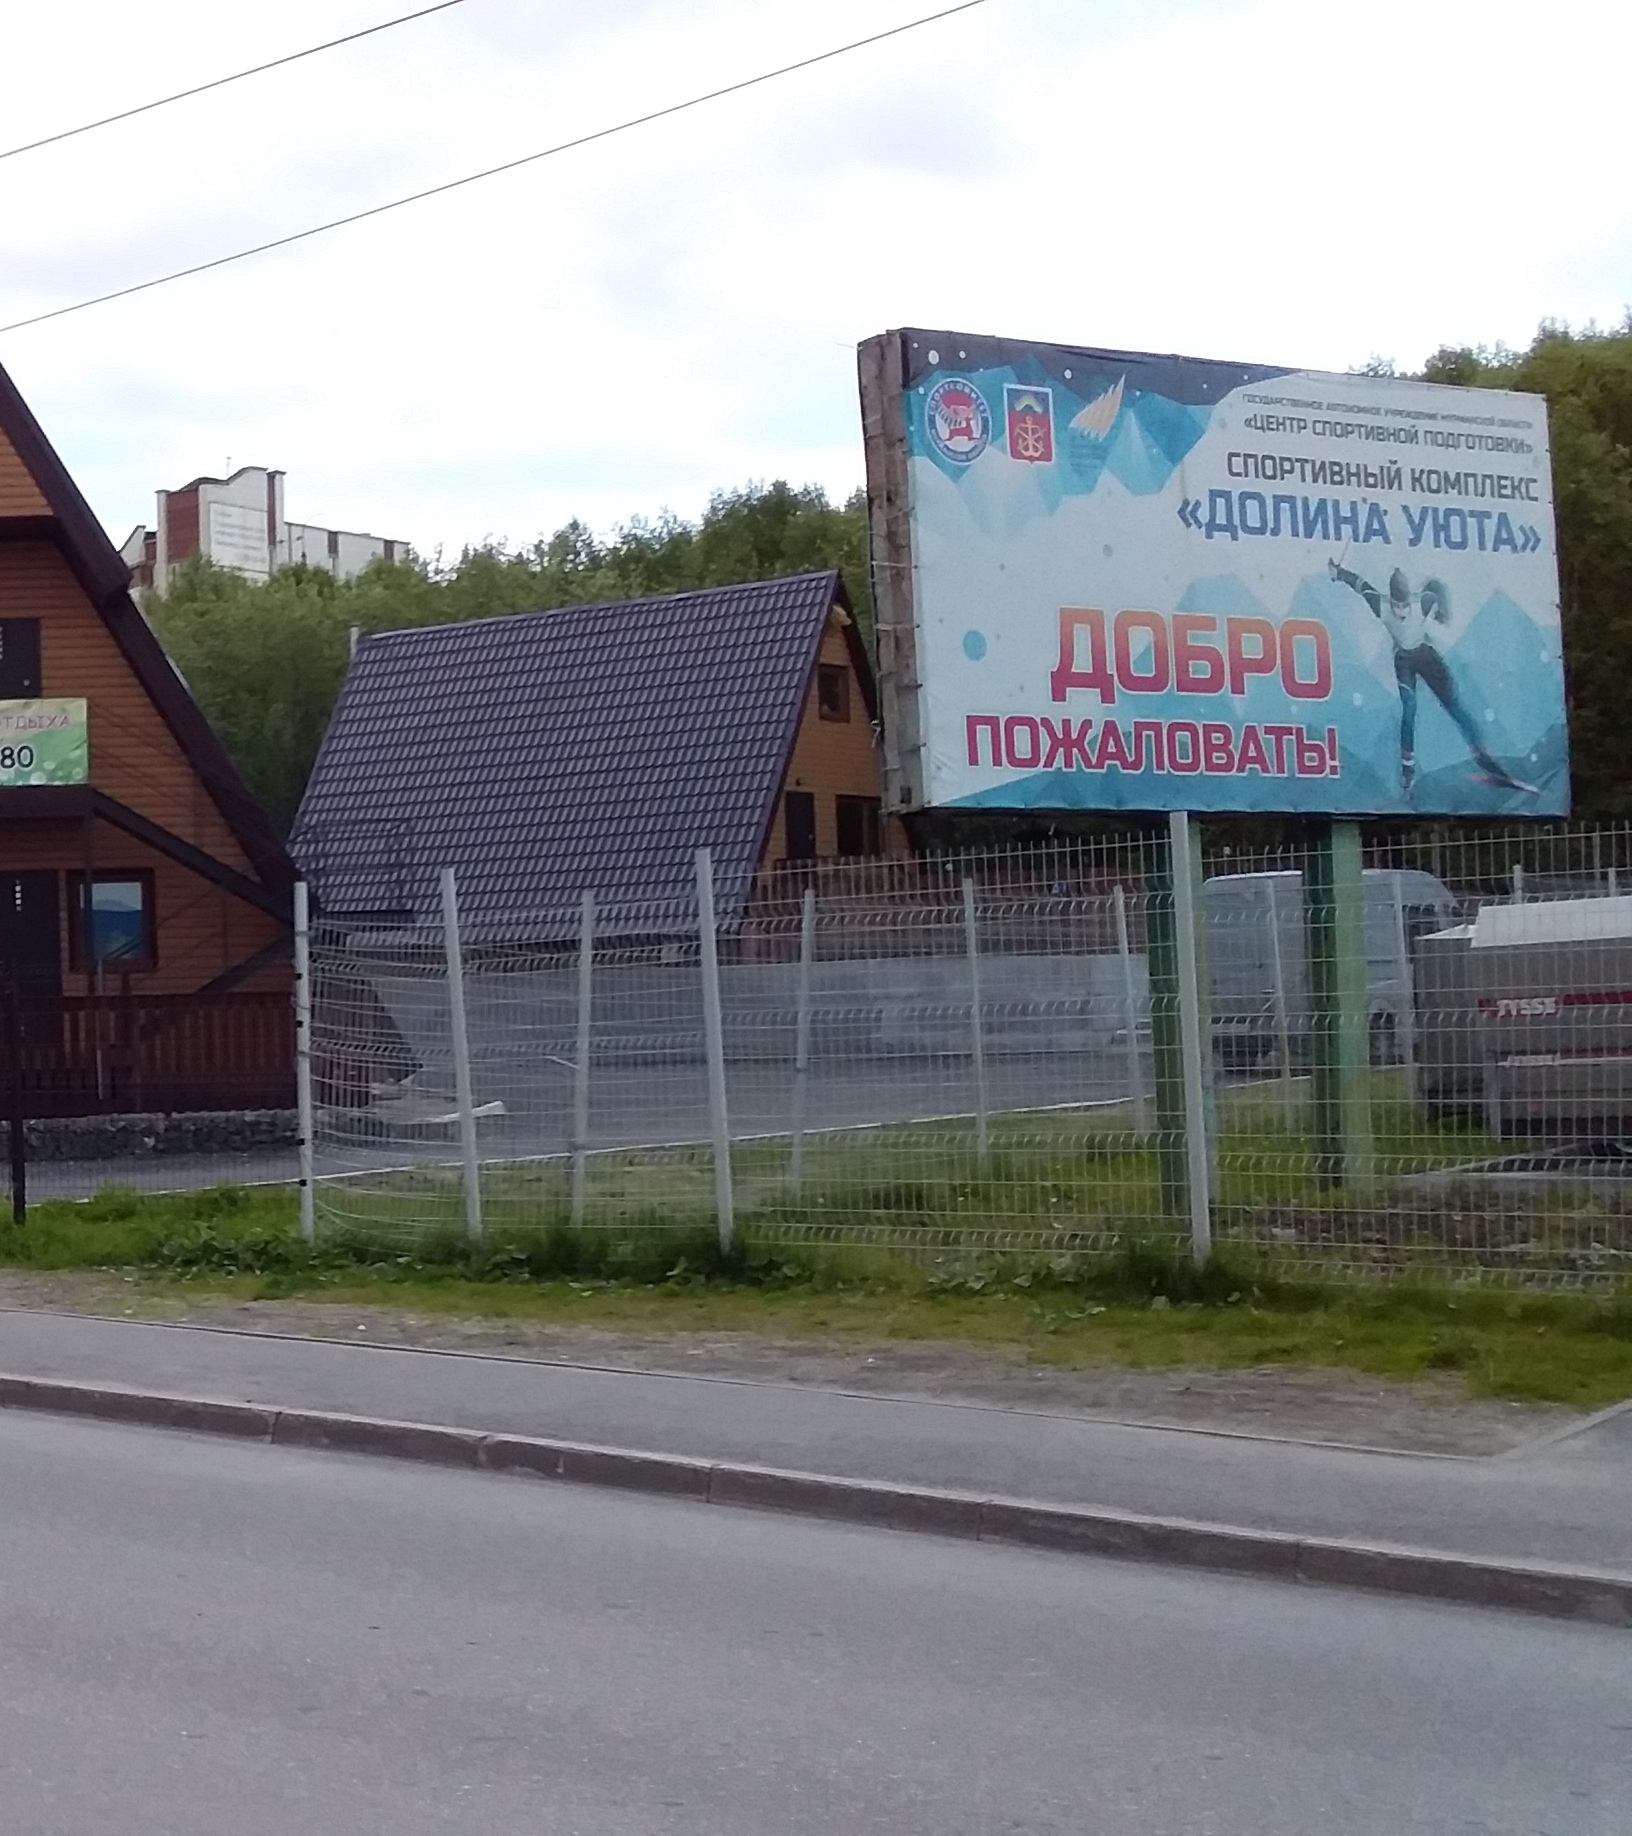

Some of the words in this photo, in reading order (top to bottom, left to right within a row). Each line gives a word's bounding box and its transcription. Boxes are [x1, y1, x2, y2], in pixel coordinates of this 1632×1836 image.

[1244, 413, 1308, 434] «ЦЕНТР
[1312, 419, 1419, 445] СПОРТИВНОЙ
[1424, 429, 1533, 454] ПОДГОТОВКИ»
[1227, 452, 1403, 492] СПОРТИВНЫЙ
[1411, 468, 1539, 502] КОМПЛЕКС
[1176, 488, 1392, 545] «ДОЛИНА
[1400, 503, 1542, 554] УЮТА»
[1049, 605, 1333, 706] ДОБРО
[965, 714, 1342, 778] ПОЖАЛОВАТЬ!
